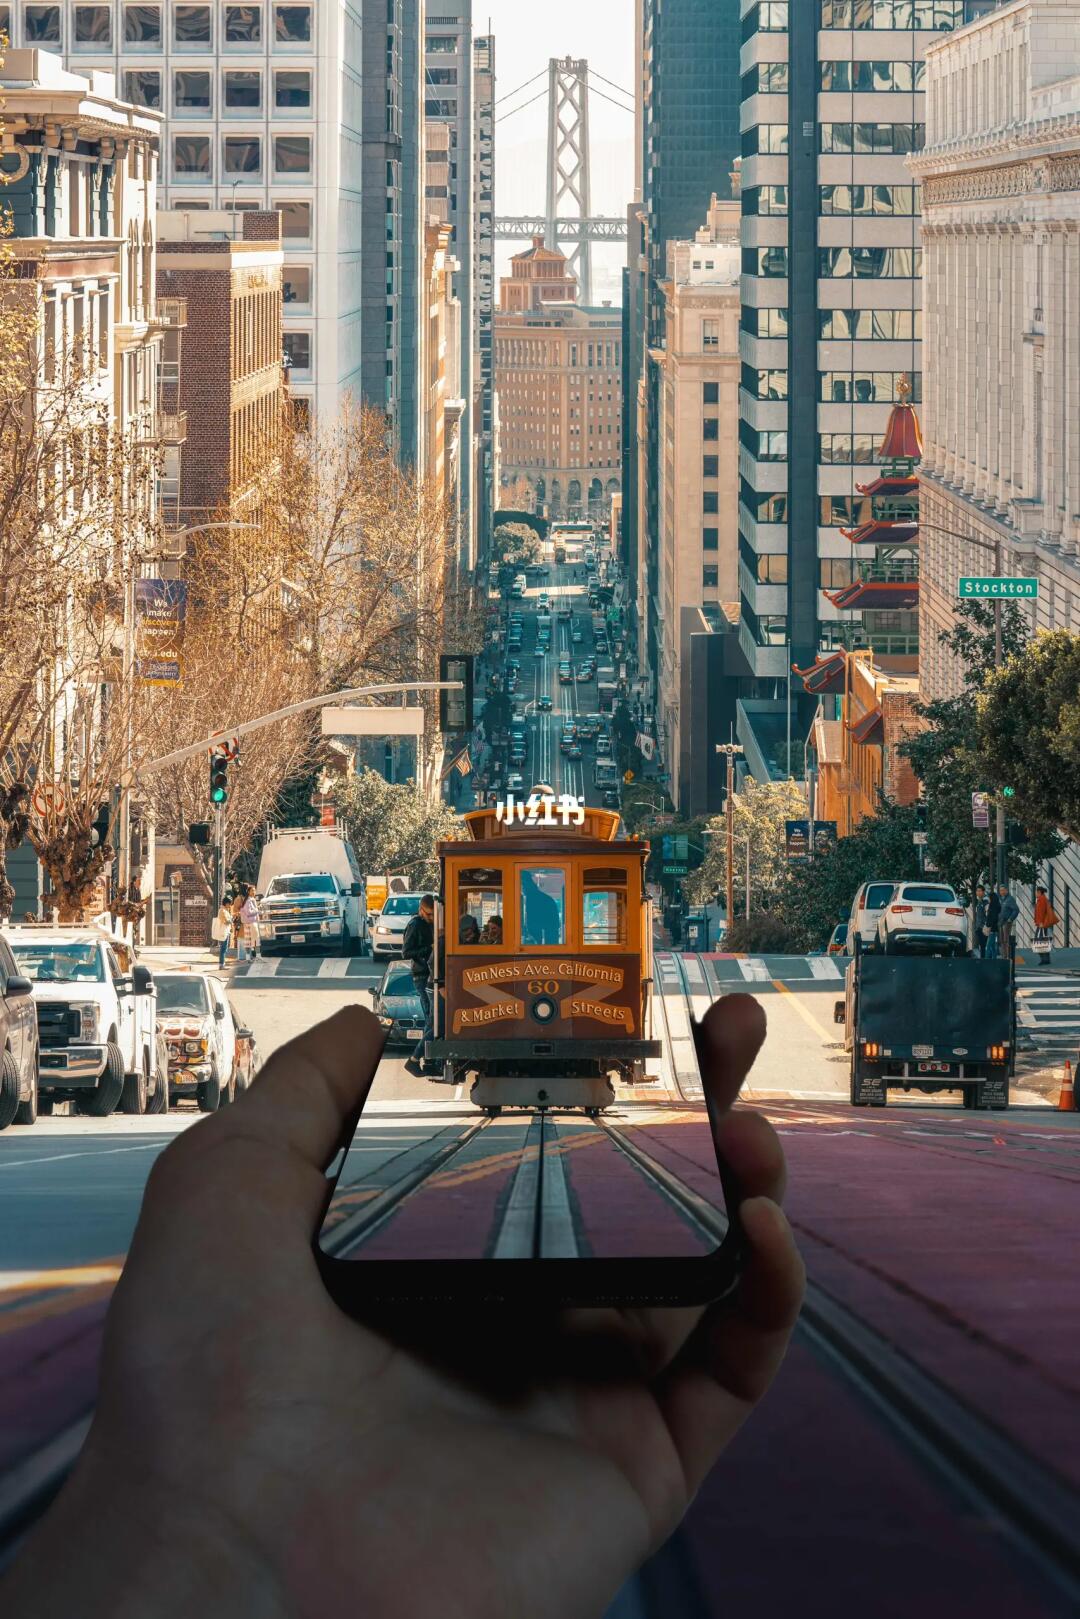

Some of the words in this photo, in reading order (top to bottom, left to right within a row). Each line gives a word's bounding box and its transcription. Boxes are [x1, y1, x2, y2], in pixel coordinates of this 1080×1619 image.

[964, 581, 1033, 594] Stockton
[466, 971, 488, 982] Van
[489, 966, 520, 979] Ness
[558, 963, 622, 982] California
[527, 980, 560, 995] 60
[461, 1009, 470, 1022] &
[473, 1003, 519, 1022] Market
[571, 1001, 625, 1020] Streets
[861, 1078, 882, 1086] SE
